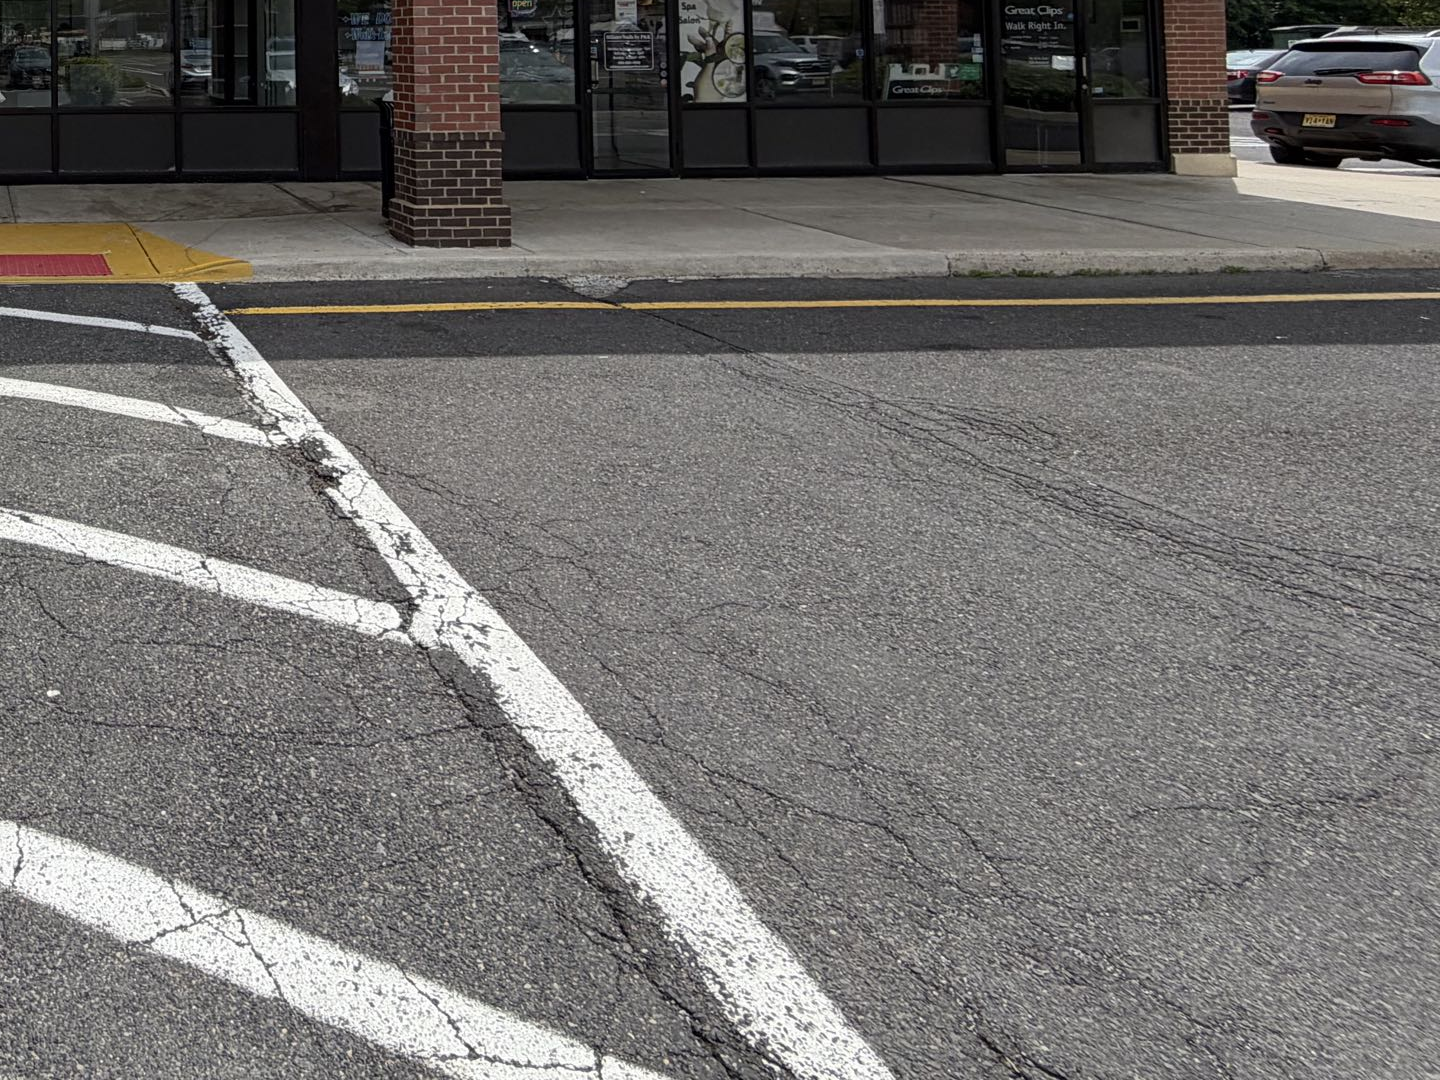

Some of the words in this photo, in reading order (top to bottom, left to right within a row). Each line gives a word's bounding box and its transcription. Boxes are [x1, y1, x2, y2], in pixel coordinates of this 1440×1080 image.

[681, 2, 697, 11] Spa
[1004, 5, 1036, 15] Great
[1037, 5, 1064, 17] Clips
[1005, 22, 1026, 31] Walk
[1028, 21, 1052, 32] Right
[892, 85, 919, 94] Great
